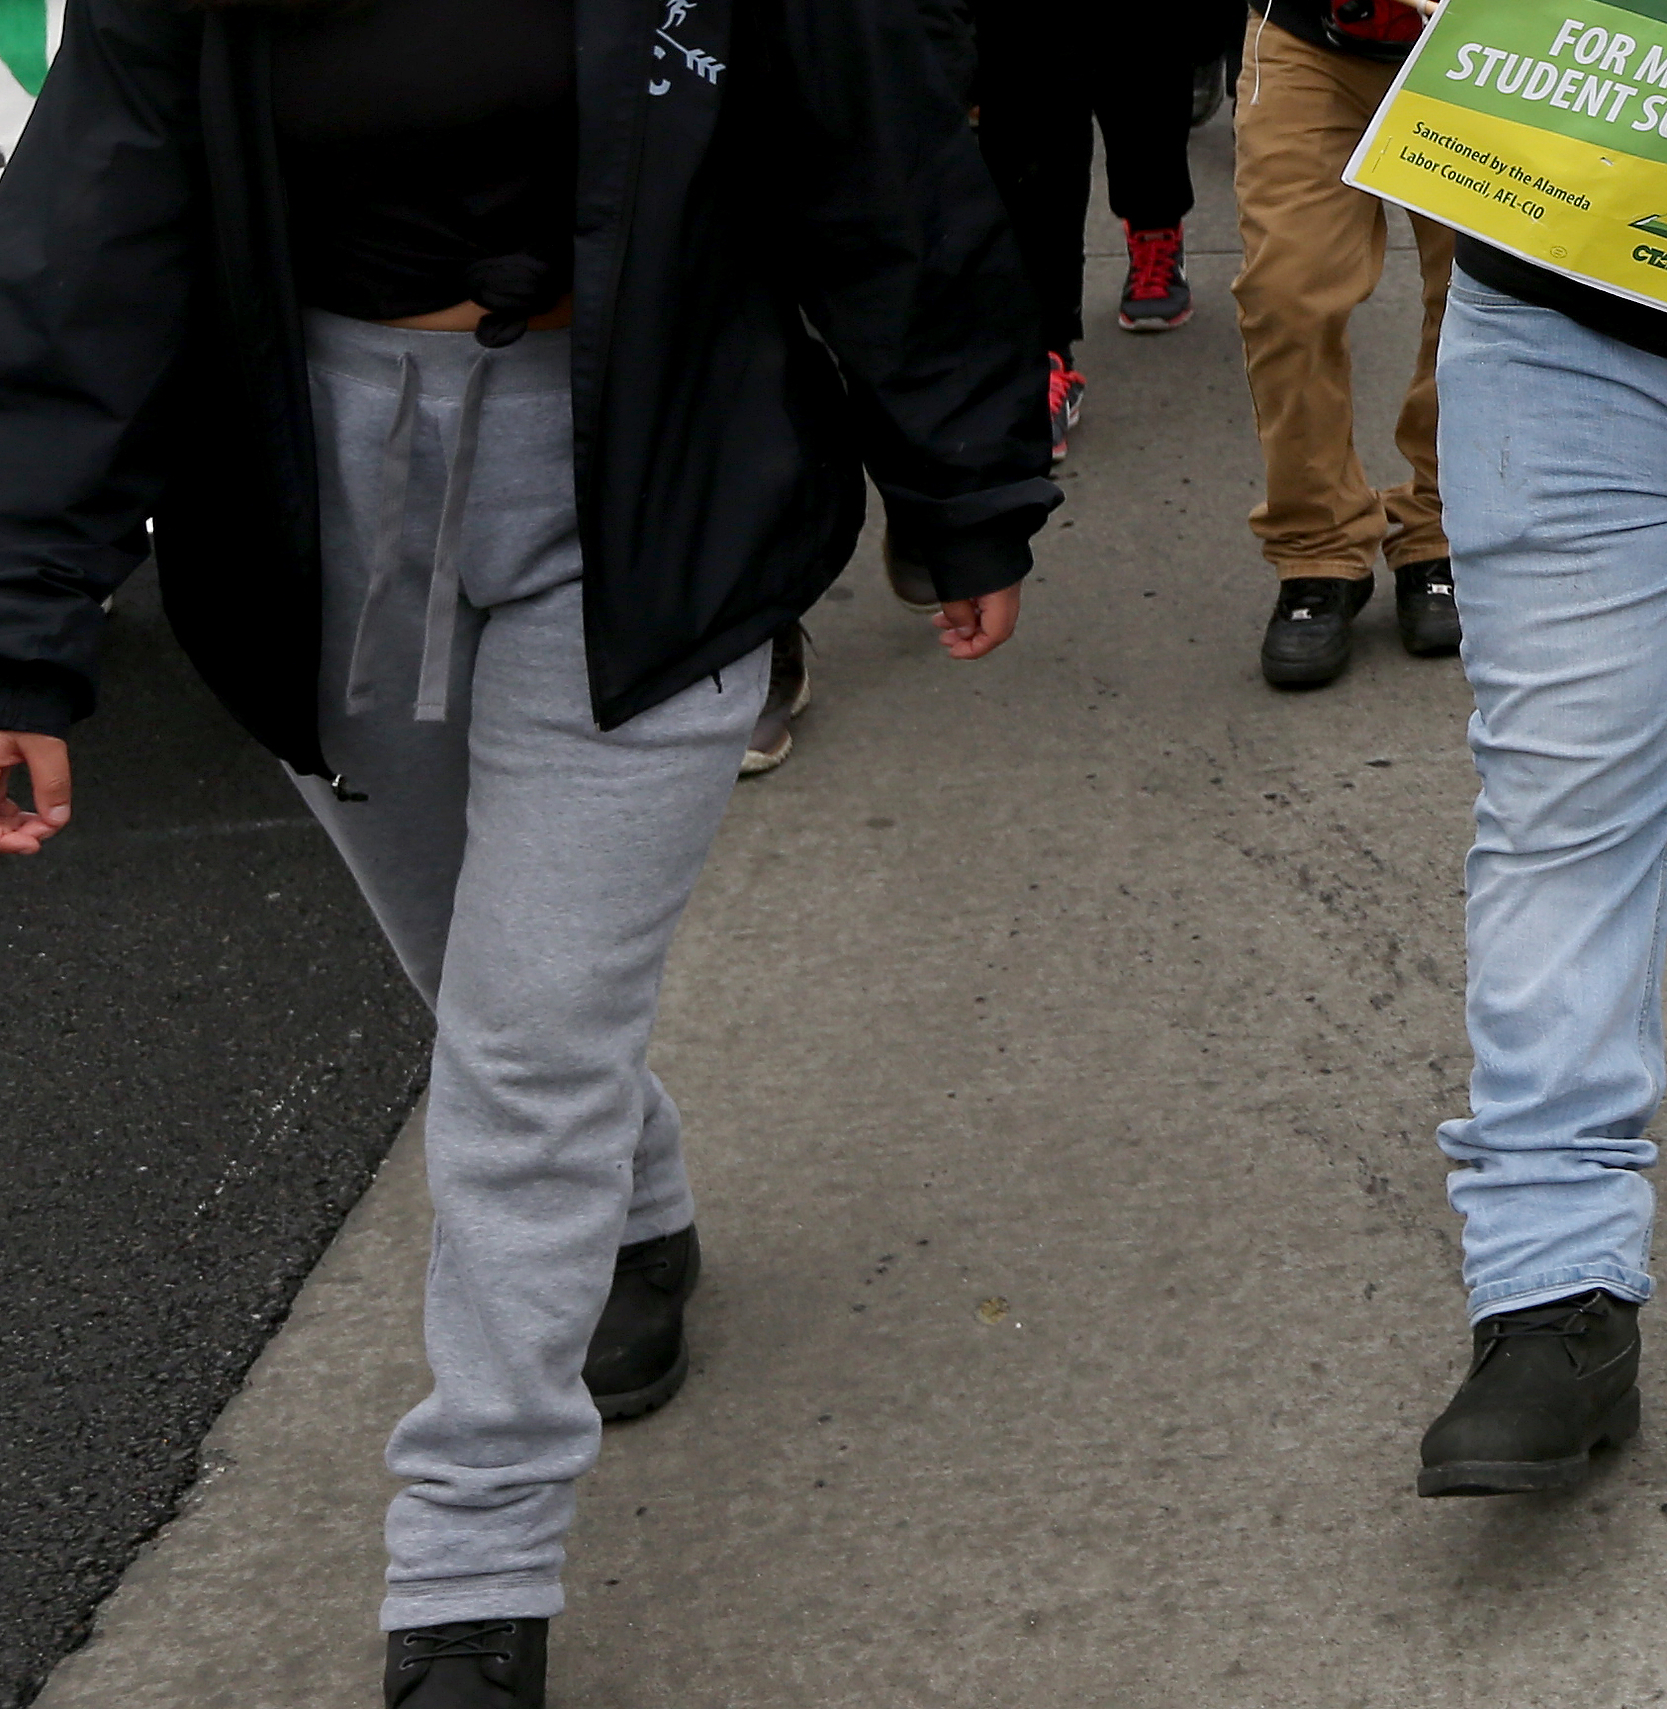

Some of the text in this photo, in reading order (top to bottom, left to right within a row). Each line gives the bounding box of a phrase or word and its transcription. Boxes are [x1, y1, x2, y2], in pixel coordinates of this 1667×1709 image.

[1445, 42, 1639, 124] STUDENT
[1549, 18, 1637, 76] FOR
[1399, 145, 1546, 221] Labor Council, AFL-CIO
[1412, 121, 1592, 211] Sanctioned by the Alameda
